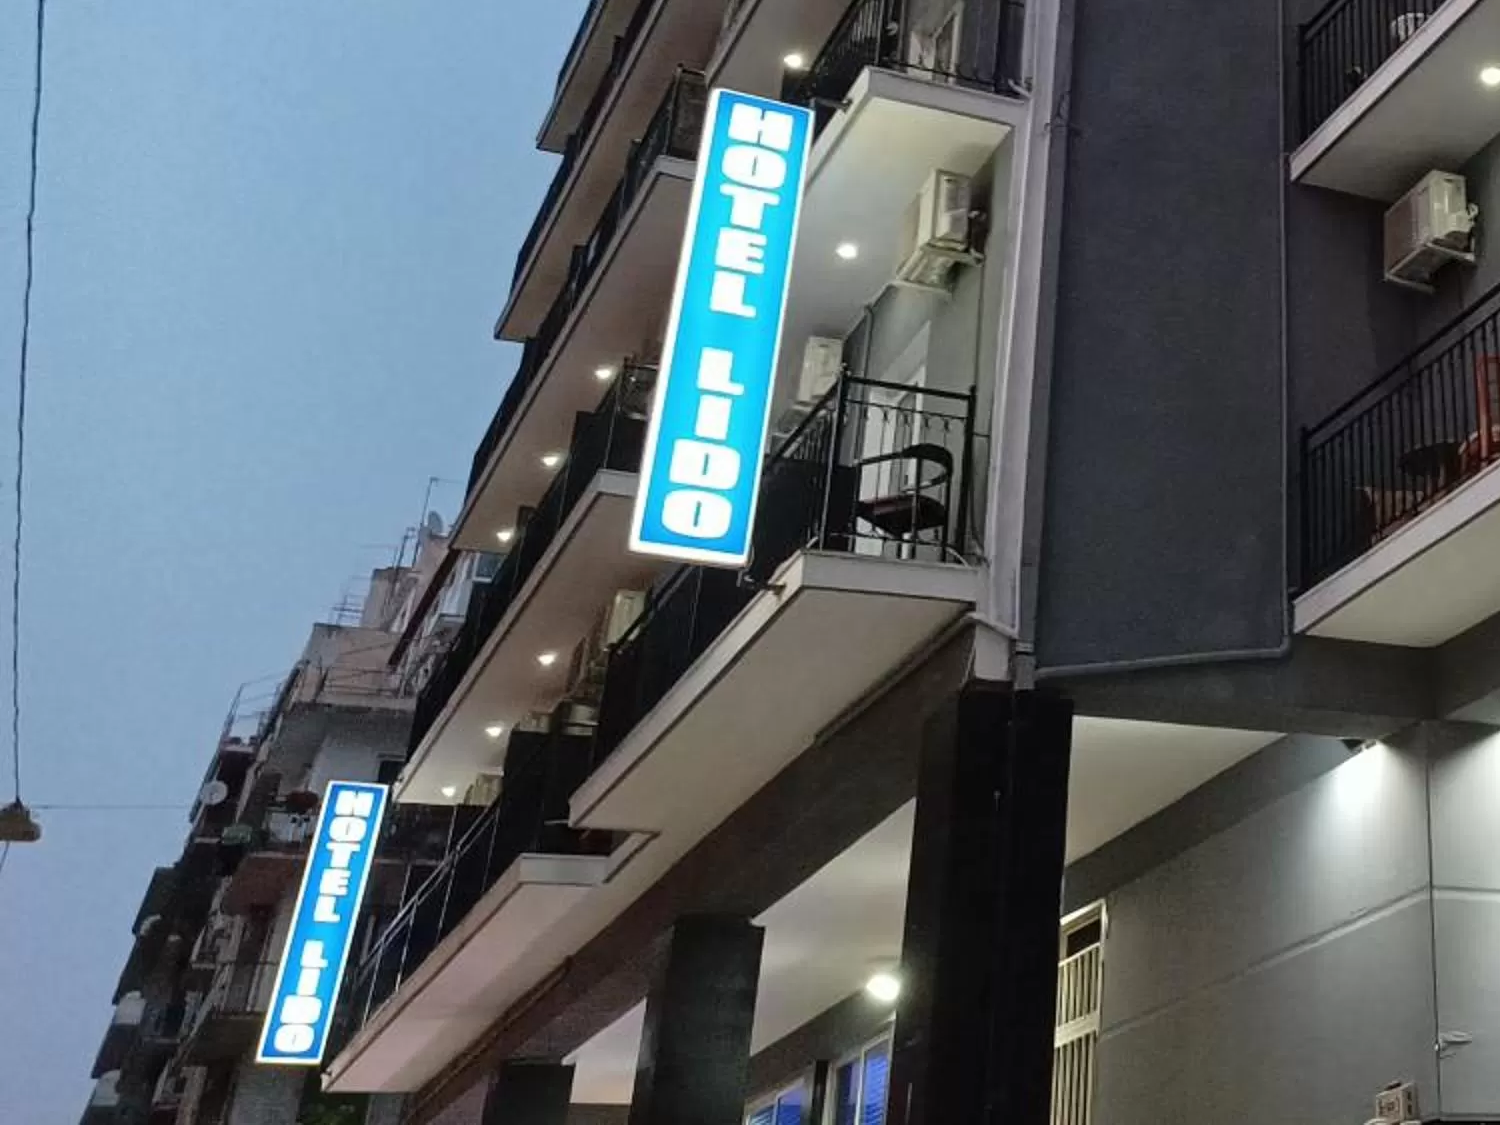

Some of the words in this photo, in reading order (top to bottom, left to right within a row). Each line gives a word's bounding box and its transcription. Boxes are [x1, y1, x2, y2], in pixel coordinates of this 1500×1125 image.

[710, 102, 794, 318] HOTEL
[661, 346, 745, 540] LIDO
[313, 790, 375, 923] HOTEL
[273, 940, 329, 1053] LIDO
